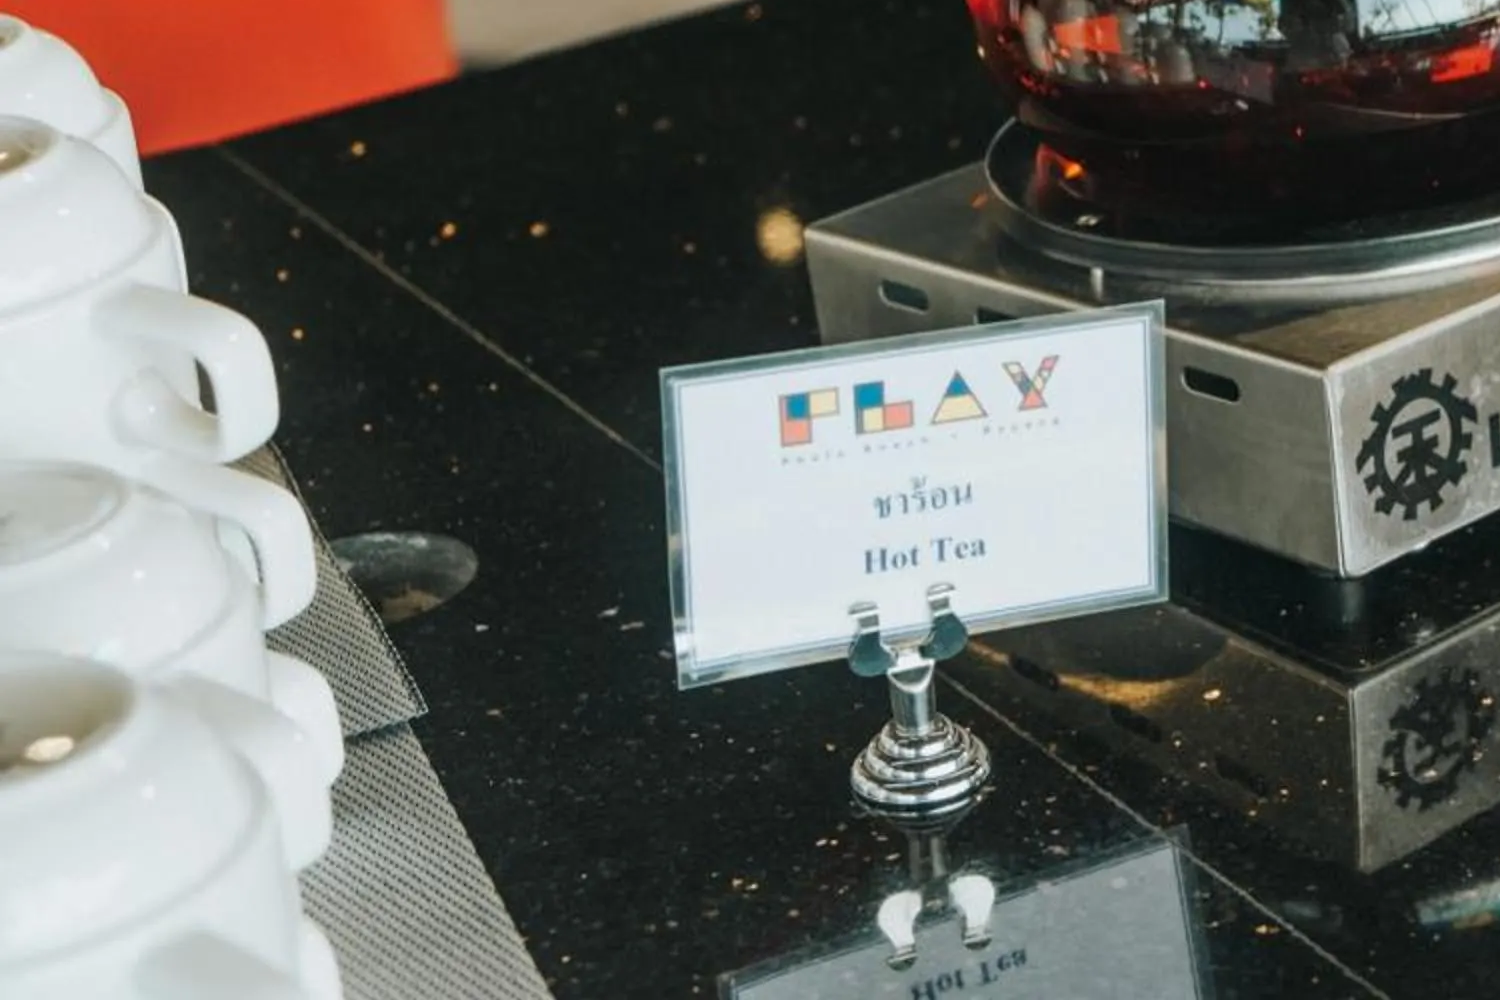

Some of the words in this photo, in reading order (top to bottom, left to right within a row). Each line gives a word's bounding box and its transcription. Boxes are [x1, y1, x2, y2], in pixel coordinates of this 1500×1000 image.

[778, 354, 1061, 448] PLAY
[872, 474, 976, 520] ชาร้อน
[863, 544, 920, 575] Hot
[930, 536, 988, 563] Tea
